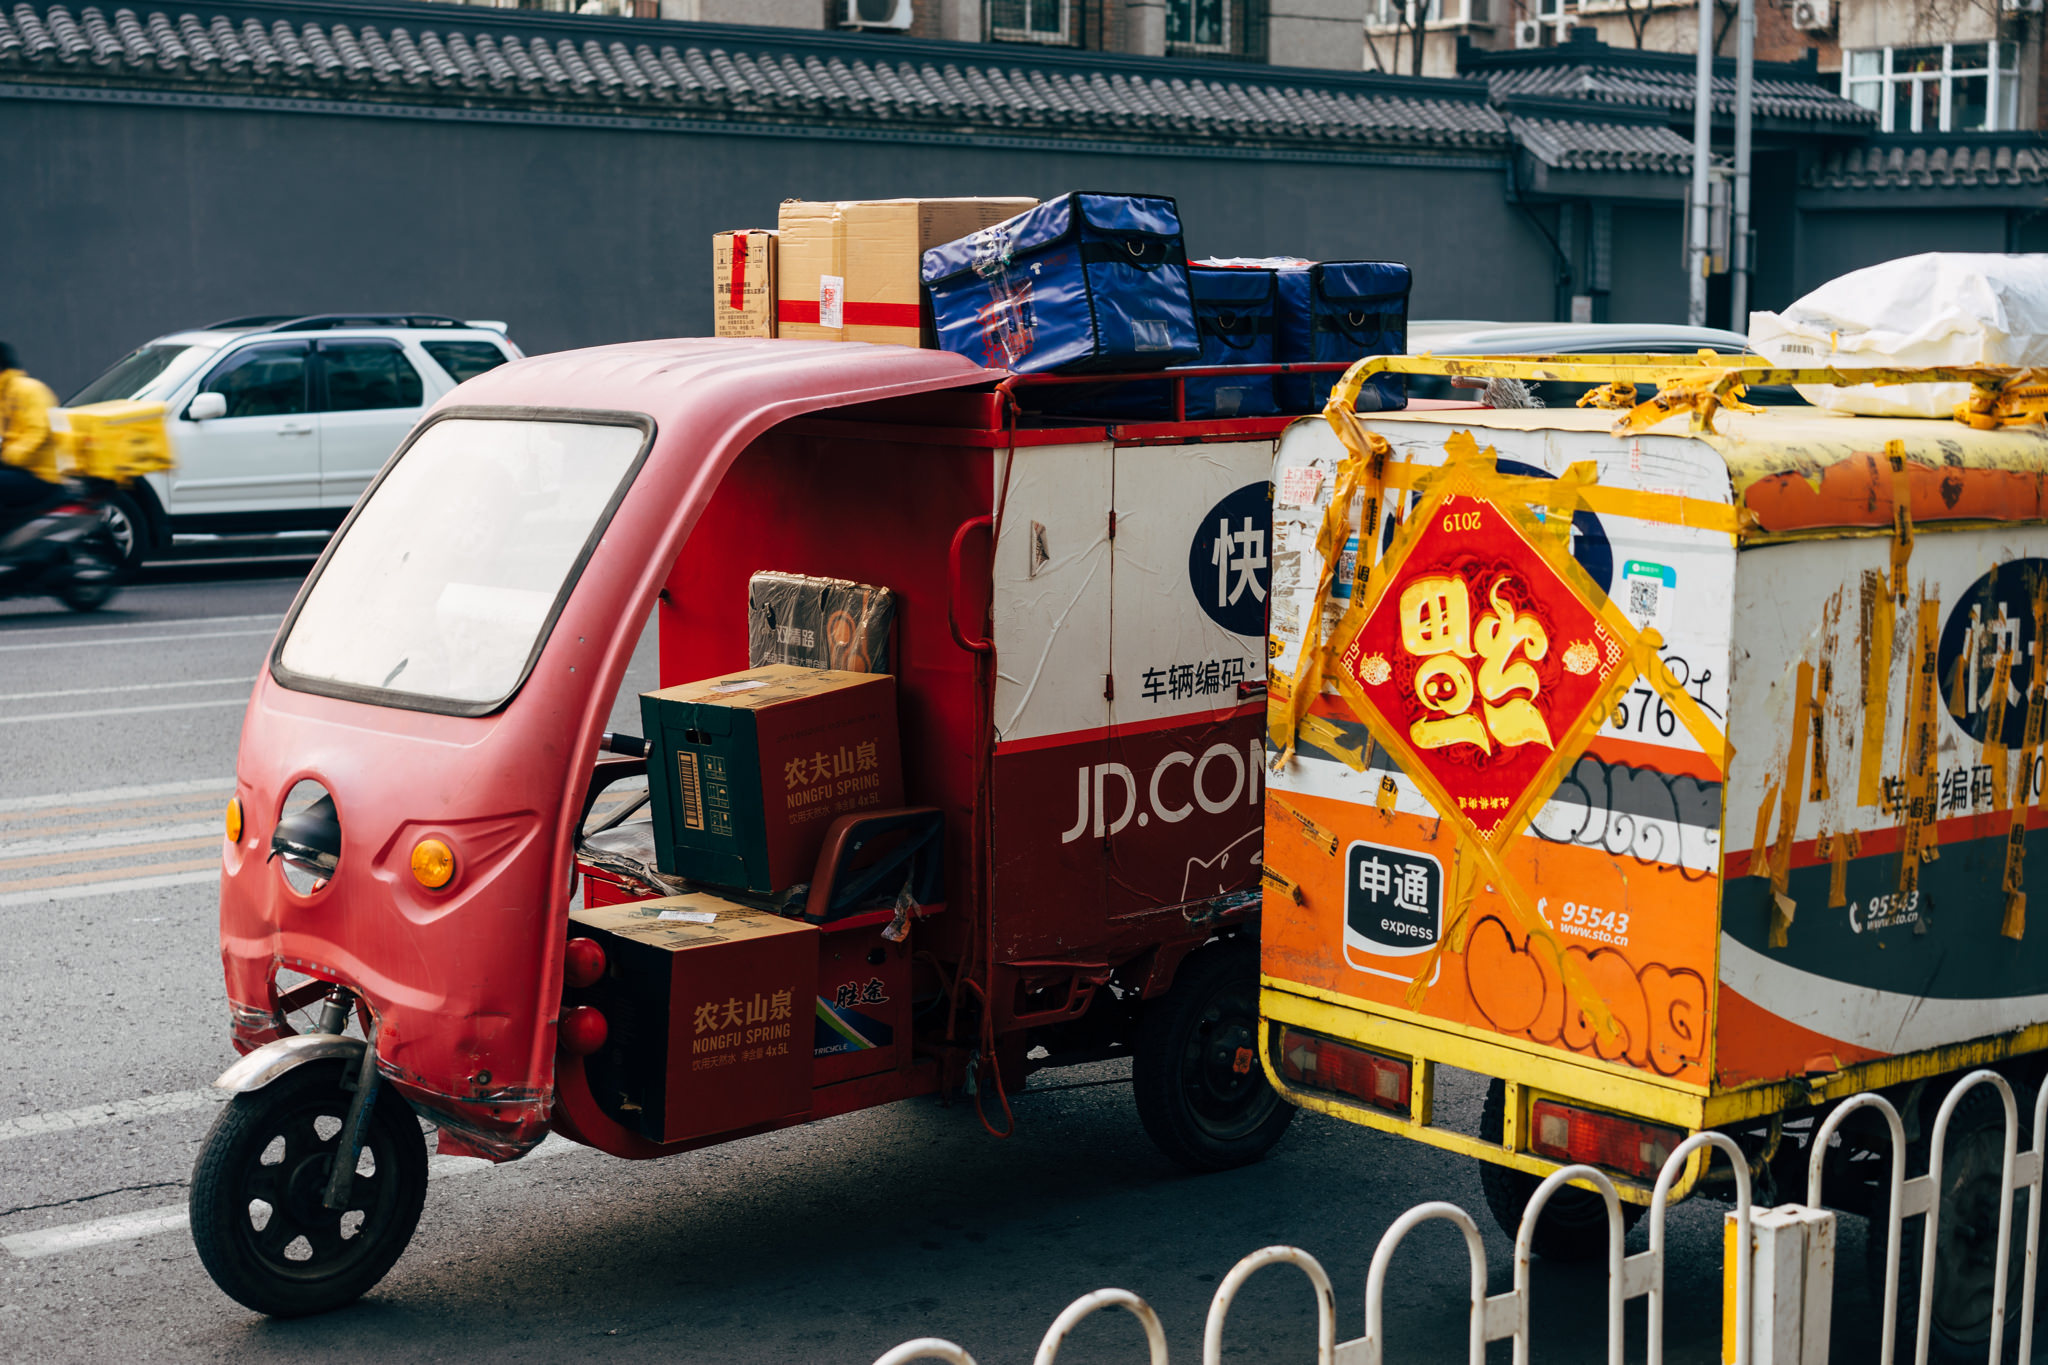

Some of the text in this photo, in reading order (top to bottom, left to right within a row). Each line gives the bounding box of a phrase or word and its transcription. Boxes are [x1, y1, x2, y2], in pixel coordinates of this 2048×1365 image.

[1442, 510, 1483, 534] 2019
[1211, 516, 1268, 608] 快
[784, 740, 879, 790] 农夫山泉
[787, 773, 880, 809] NONGFU SPRING
[1359, 855, 1430, 915] 申通
[1380, 917, 1434, 942] express
[1559, 922, 1630, 947] www.sto.cn
[1560, 900, 1630, 935] 95543
[833, 976, 890, 1011] 胜途
[692, 988, 793, 1036] 农夫山泉
[692, 1022, 791, 1055] NONGFU SPRING
[765, 1041, 790, 1058] 4x5L
